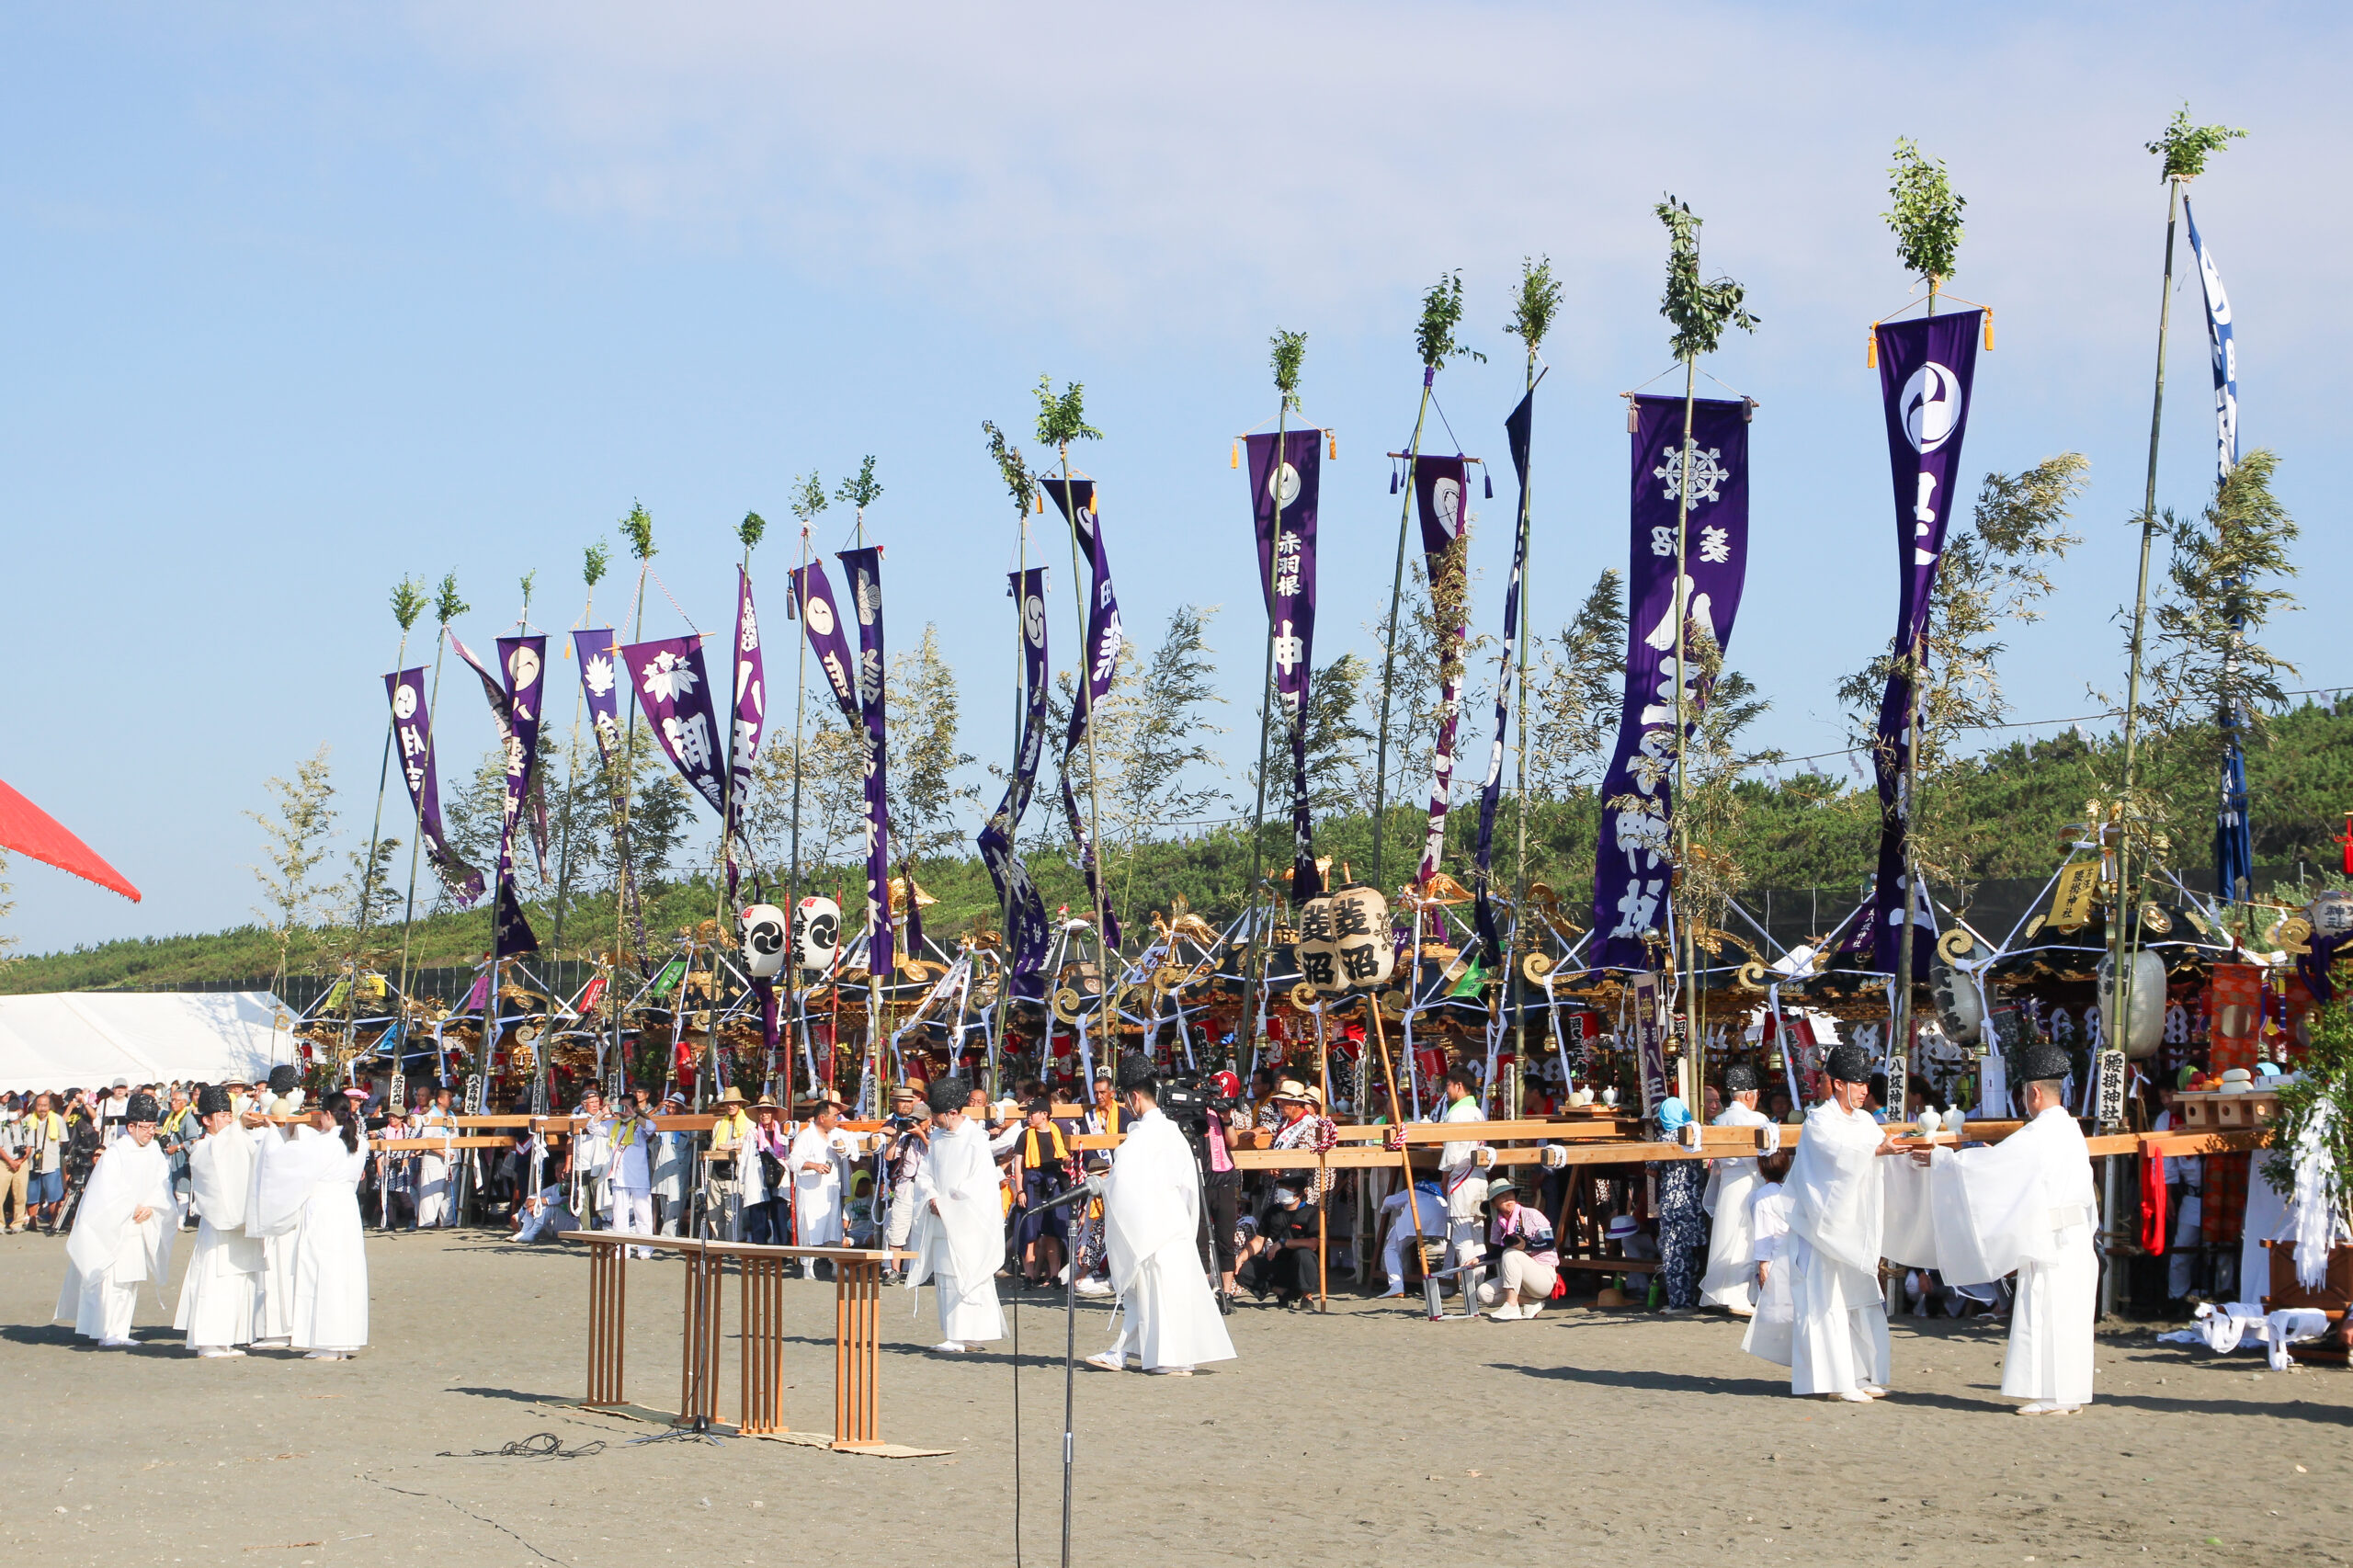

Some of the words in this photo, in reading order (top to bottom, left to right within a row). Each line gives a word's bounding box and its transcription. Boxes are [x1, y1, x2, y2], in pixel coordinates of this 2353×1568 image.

[1277, 530, 1302, 597] 赤羽根
[2061, 869, 2085, 919] 腰掛神社
[1302, 904, 1335, 984] 菱沼
[1334, 898, 1379, 981] 菱沼
[465, 1075, 480, 1112] 八雲神社
[1356, 1062, 1364, 1113] 八雲大神
[1888, 1059, 1904, 1121] 八坂神社
[2101, 1053, 2123, 1119] 腰掛神社
